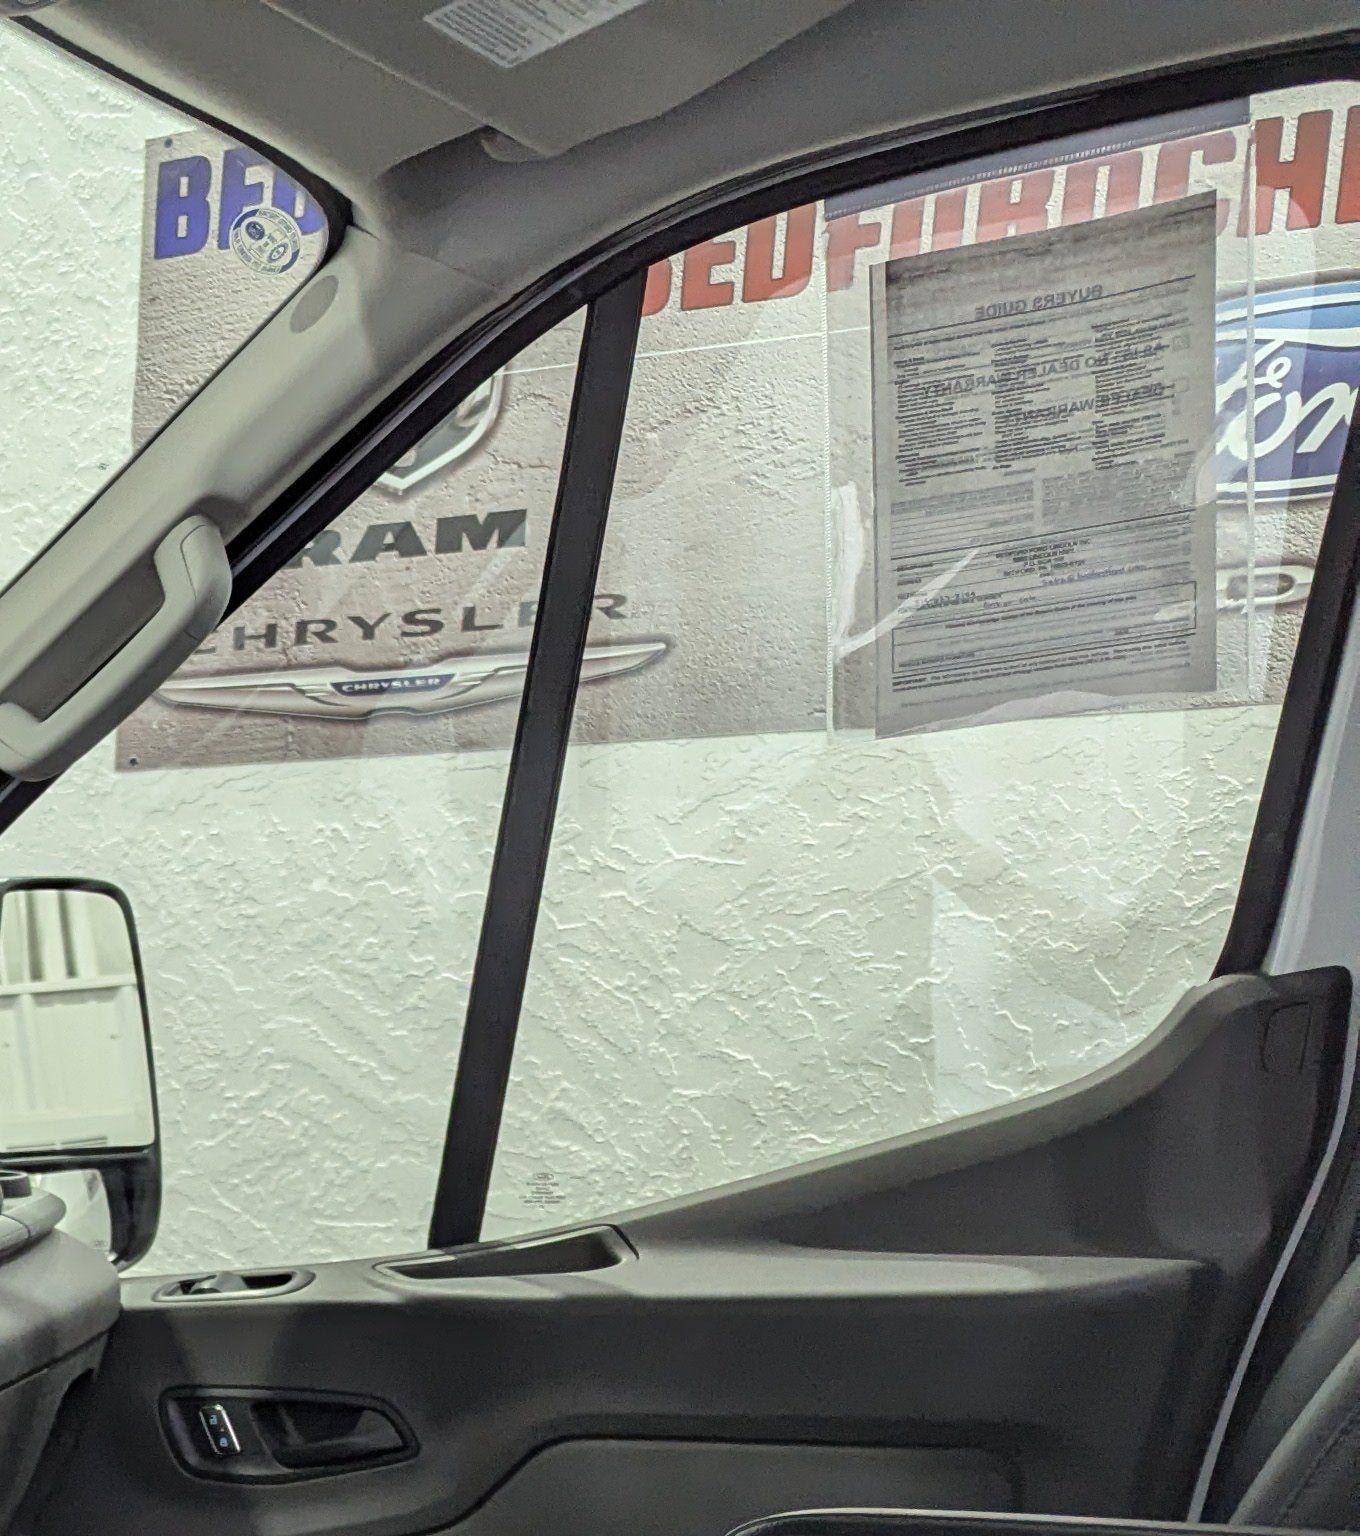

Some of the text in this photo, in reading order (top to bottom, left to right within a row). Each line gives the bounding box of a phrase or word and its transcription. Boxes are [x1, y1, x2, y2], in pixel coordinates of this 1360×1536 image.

[281, 509, 527, 569] RAM
[192, 594, 627, 655] HRYSLR
[341, 678, 441, 693] CHRYSLER
